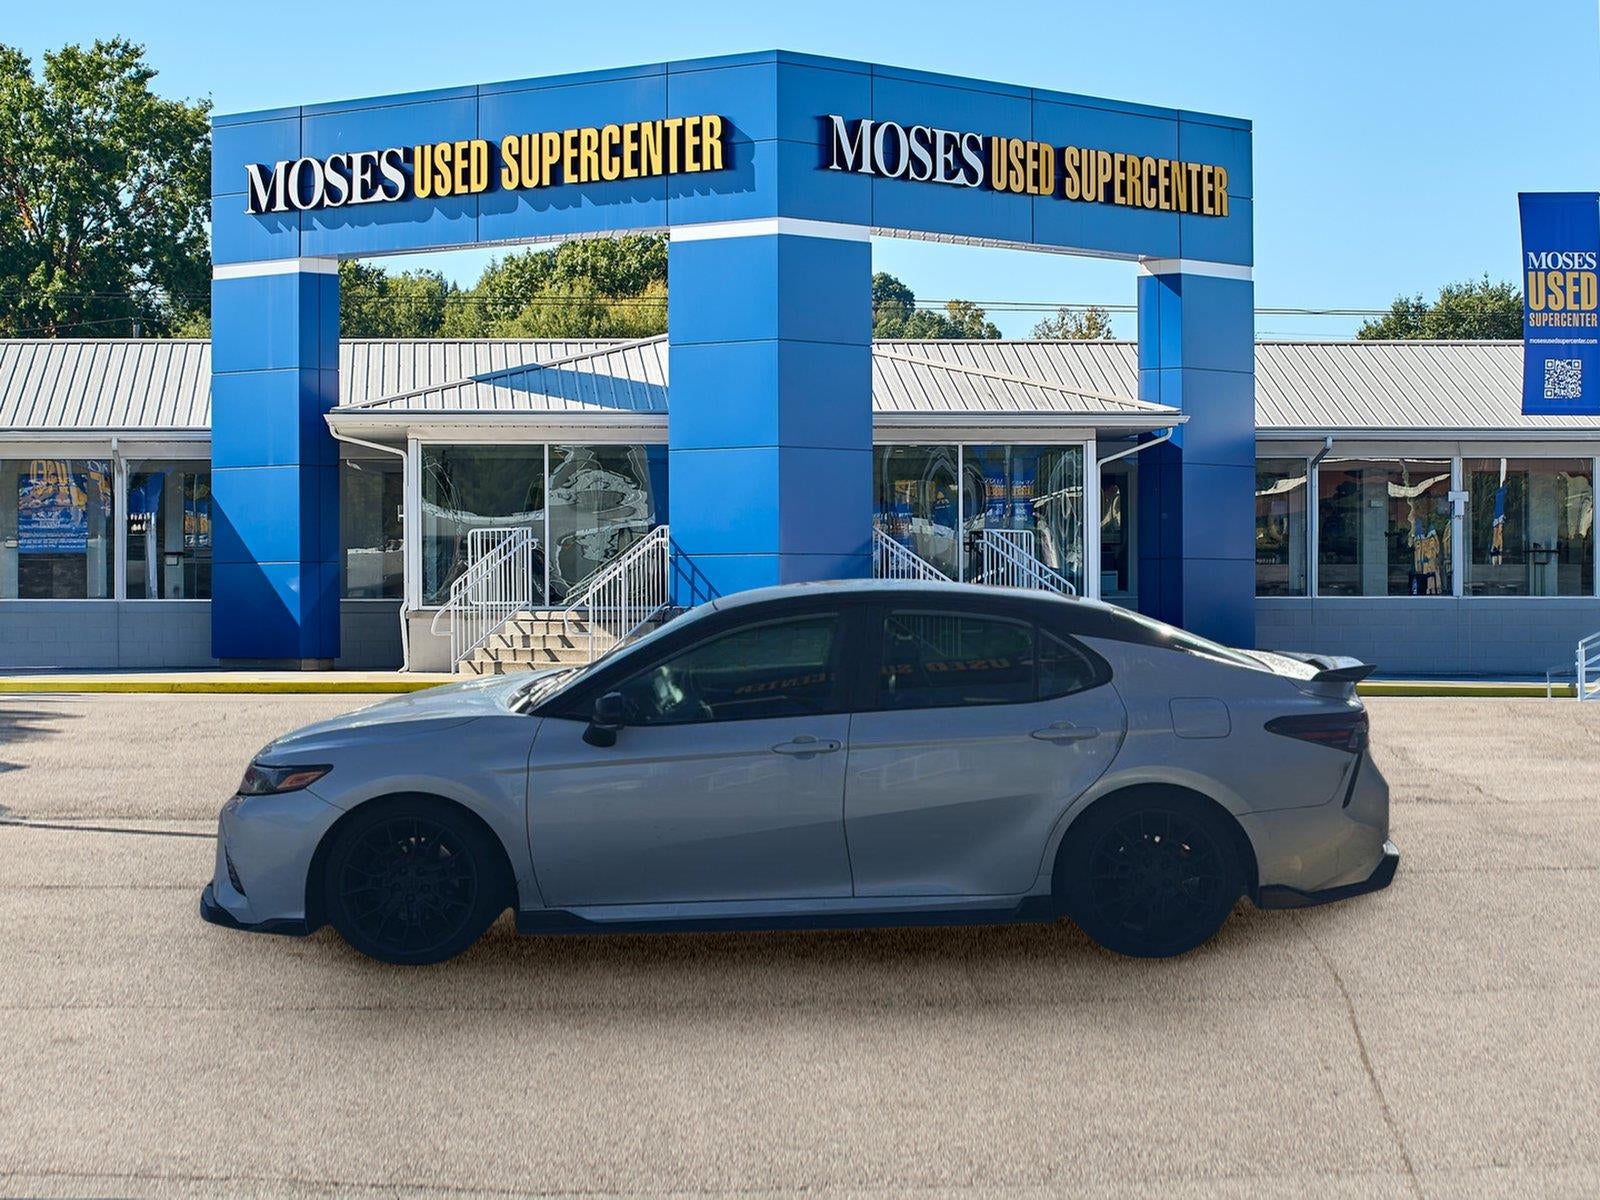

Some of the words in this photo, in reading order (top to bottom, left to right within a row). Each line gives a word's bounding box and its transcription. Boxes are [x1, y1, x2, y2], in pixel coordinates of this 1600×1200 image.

[244, 147, 405, 214] MOSES
[413, 138, 488, 199] USED
[501, 114, 723, 190] SUPERCENTER
[829, 114, 984, 187] MOSES
[991, 136, 1055, 195] USED
[1064, 146, 1229, 217] SUPERCENTER
[1527, 251, 1597, 270] MOSES
[1527, 271, 1598, 311] USED
[1529, 312, 1598, 327] SUPERCENTER
[1529, 337, 1598, 345] mosesusedsupercenter.com
